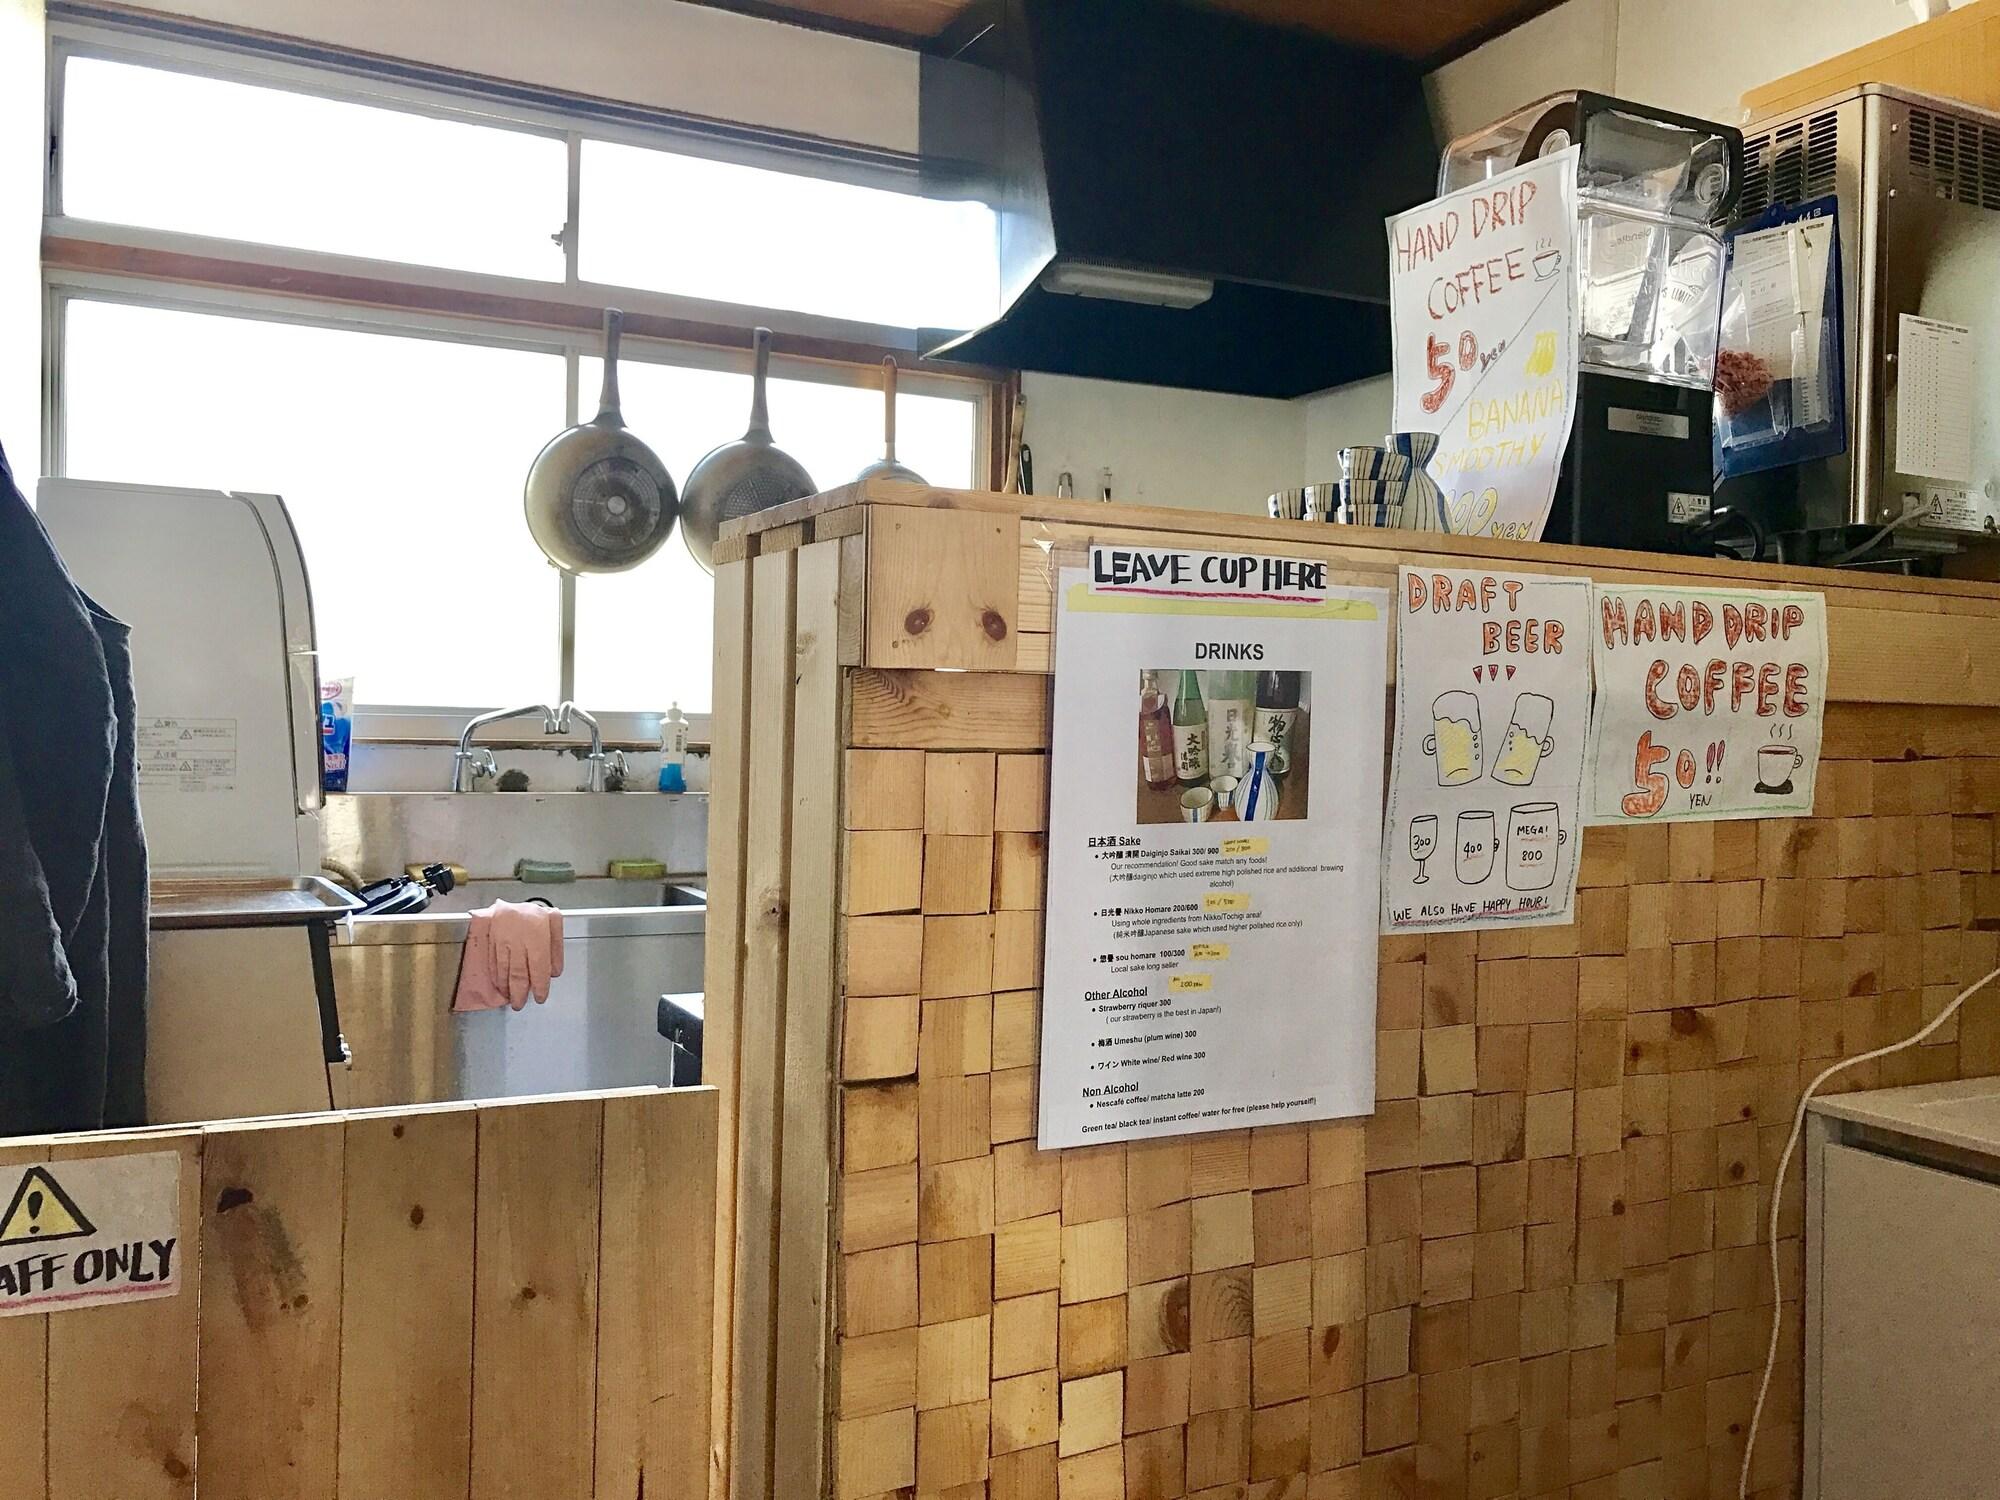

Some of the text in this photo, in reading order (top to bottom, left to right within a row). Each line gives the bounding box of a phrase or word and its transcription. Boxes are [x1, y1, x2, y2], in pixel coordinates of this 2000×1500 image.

[1394, 181, 1537, 274] HAND DRIP
[1428, 248, 1525, 320] COFFEE
[1420, 330, 1478, 414] 50
[1467, 378, 1564, 440] BANANA
[1094, 550, 1327, 591] LEAVE CUP HERE
[1408, 573, 1523, 614] DRAFT
[1601, 596, 1804, 650] HAND DRIP
[1483, 619, 1564, 655] BEER
[1195, 642, 1264, 660] DRINKS
[1645, 658, 1809, 720] COFFEE
[1689, 794, 1712, 809] YEN
[1517, 826, 1548, 838] MEGA!
[1088, 836, 1141, 847] 日本酒 Sake
[1413, 835, 1431, 850] 300
[1463, 842, 1482, 858] 400
[1522, 850, 1543, 861] 800
[1195, 870, 1221, 878] extreme
[1124, 907, 1144, 915] Nikko
[1144, 906, 1172, 914] Homare
[1393, 897, 1549, 921] WE ALSO HAVE HAPPY HOUR!
[1176, 926, 1192, 934] sake
[1192, 925, 1211, 933] which
[1212, 924, 1228, 932] used
[1130, 952, 1156, 960] homare
[1110, 965, 1129, 973] Local
[1129, 964, 1145, 972] sake
[1146, 963, 1160, 971] long
[1084, 987, 1148, 1001] Other Alcohol
[1098, 1003, 1137, 1013] Strawberry
[1159, 999, 1172, 1007] 300
[1122, 1012, 1156, 1021] strawberry
[1175, 1009, 1190, 1017] best
[1114, 1035, 1143, 1045] Umeshu
[1144, 1034, 1164, 1043] (plum
[1165, 1031, 1183, 1040] wine)
[1184, 1030, 1197, 1038] 300
[1098, 1061, 1119, 1070] ワイン
[1120, 1058, 1141, 1067] White
[1161, 1054, 1175, 1063] Red
[1175, 1053, 1193, 1061] wine
[1194, 1051, 1206, 1060] 300
[1082, 1082, 1139, 1097] Non Alcohol
[1150, 1092, 1176, 1101] matcha
[1176, 1090, 1192, 1099] latte
[1192, 1088, 1205, 1096] 200
[1081, 1123, 1103, 1133] Green
[1118, 1119, 1138, 1128] black
[1201, 1109, 1220, 1118] water
[1221, 1107, 1232, 1115] for
[1232, 1106, 1245, 1114] free
[0, 1238, 177, 1296] AFF ONLY
